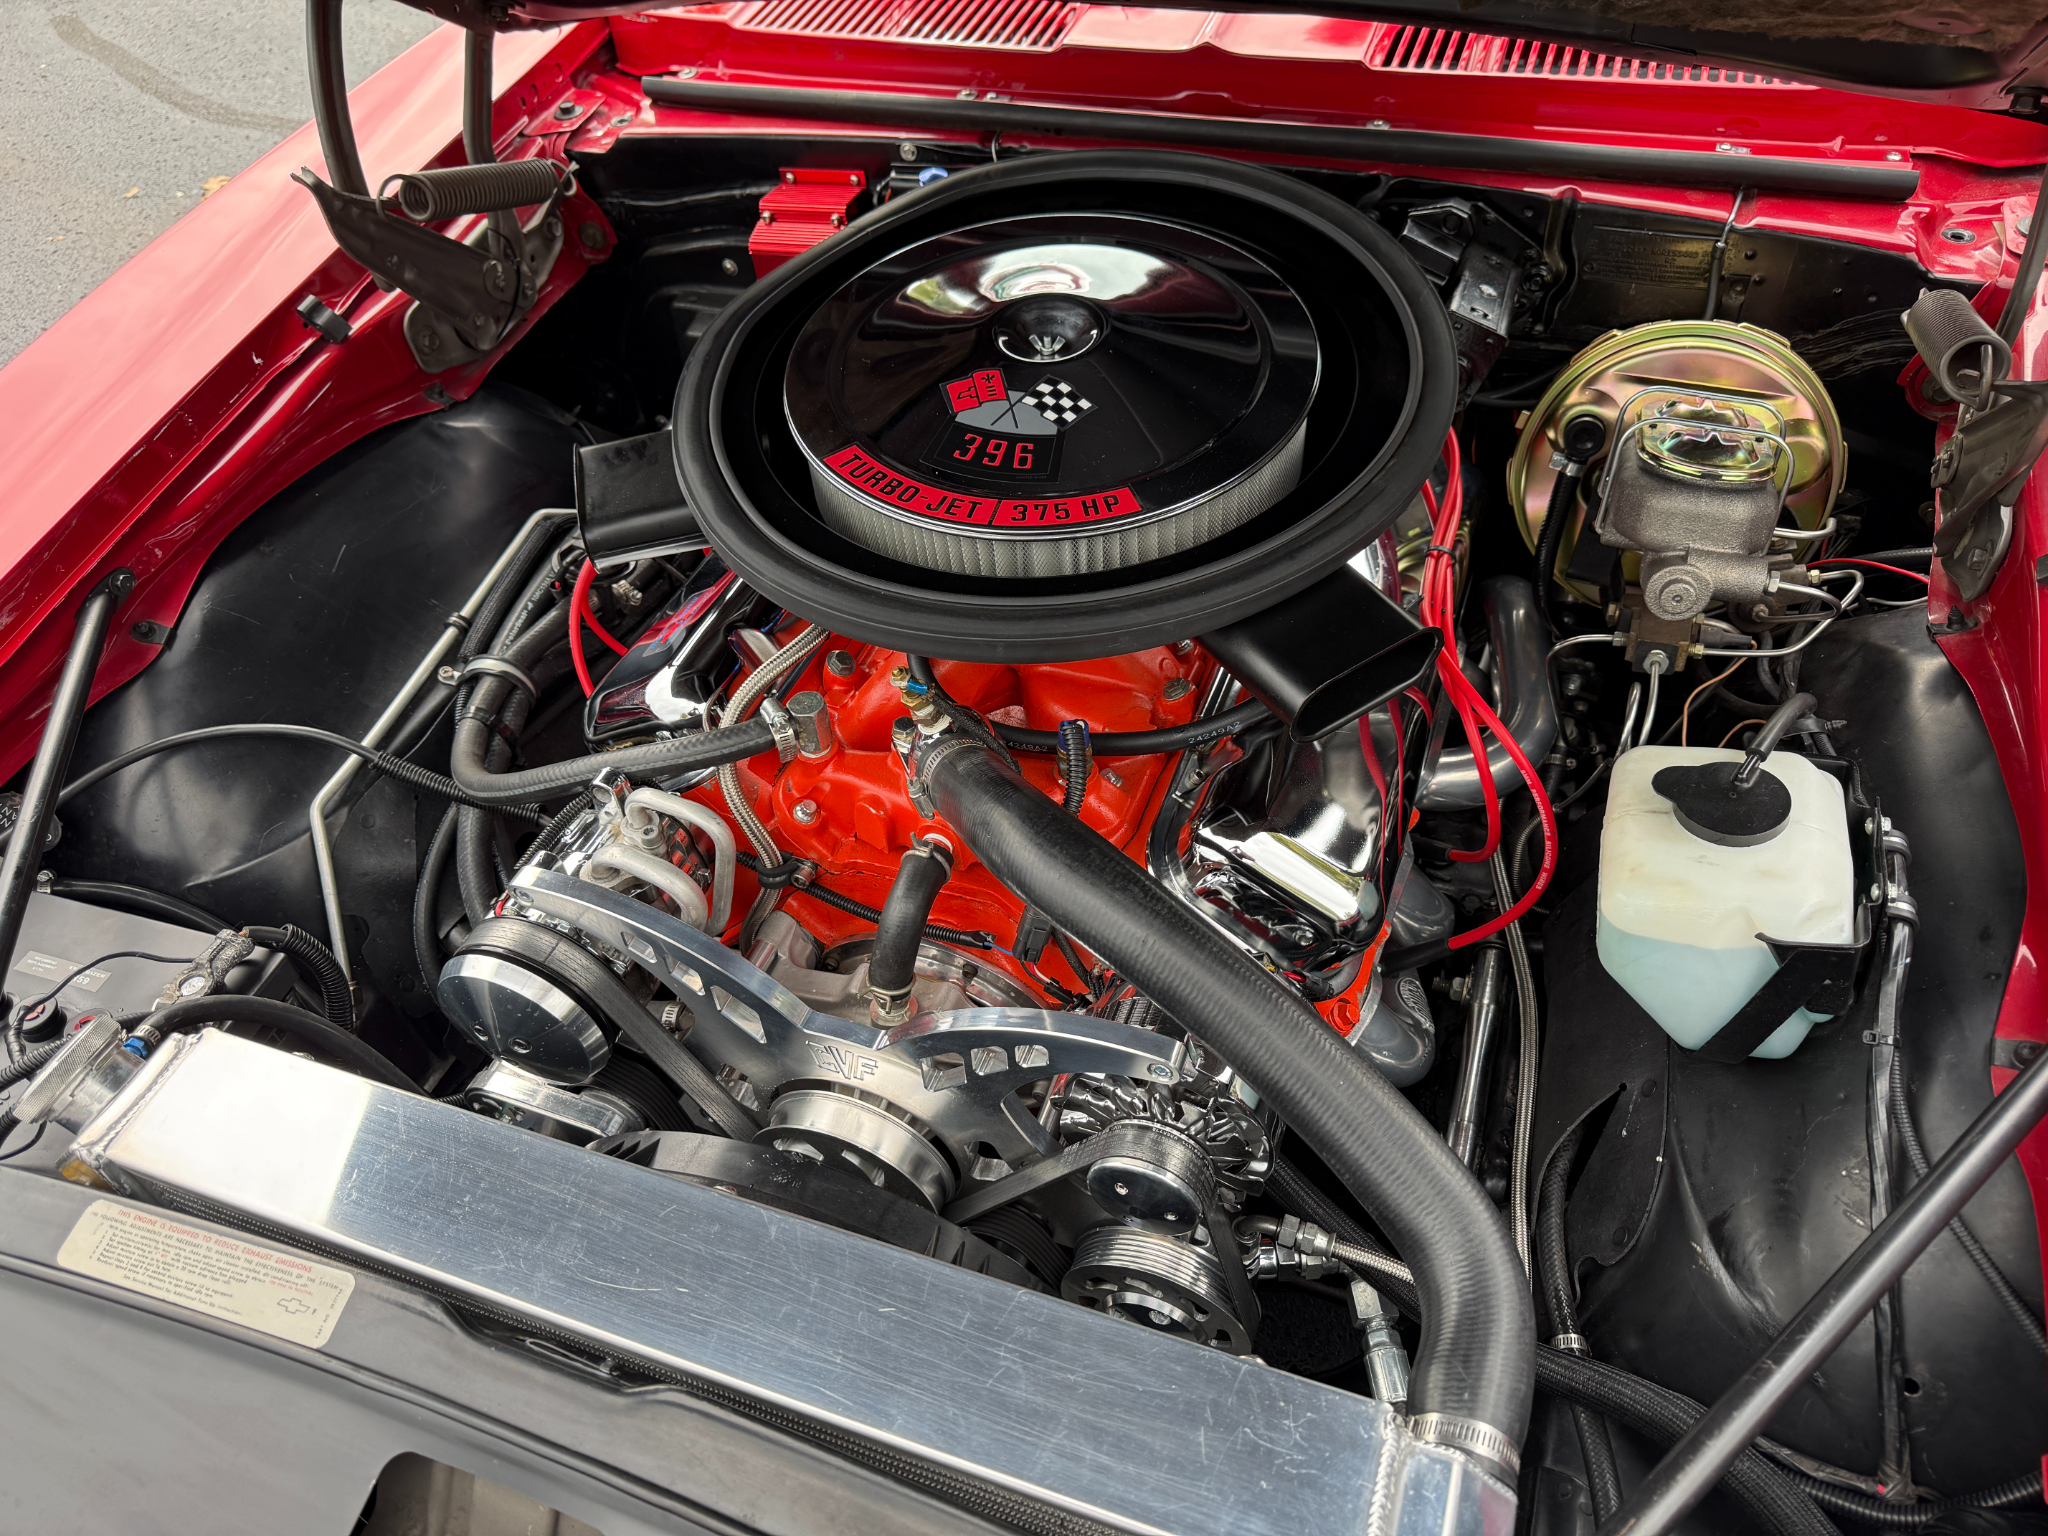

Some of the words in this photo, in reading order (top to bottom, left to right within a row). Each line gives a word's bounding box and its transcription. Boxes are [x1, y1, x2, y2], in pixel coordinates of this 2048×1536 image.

[953, 433, 1034, 470] 396
[838, 453, 983, 520] TURBO-JET
[1010, 502, 1071, 522] 375
[1083, 494, 1120, 518] HP
[1188, 721, 1242, 744] 24249A2
[1530, 788, 1551, 837] PERFORMANCE
[1543, 840, 1552, 869] SILICONE
[1535, 872, 1549, 890] WIRES
[68, 965, 106, 979] ENGIZER
[805, 1040, 879, 1081] CVF
[98, 1213, 128, 1226] FOLLOWING
[128, 1222, 163, 1236] ADJUSTMENTS
[174, 1236, 203, 1249] NECESSARY
[214, 1248, 242, 1261] MAINTAIN
[254, 1260, 293, 1277] EFFECTIVENESS
[317, 1279, 339, 1290] SYSTEM
[116, 1209, 132, 1218] THIS
[132, 1214, 158, 1226] ENGINE
[167, 1224, 200, 1239] EQUIPPED
[212, 1238, 240, 1251] REDUCE
[240, 1246, 273, 1261] EXHAUST
[274, 1256, 313, 1273] EMISSIONS
